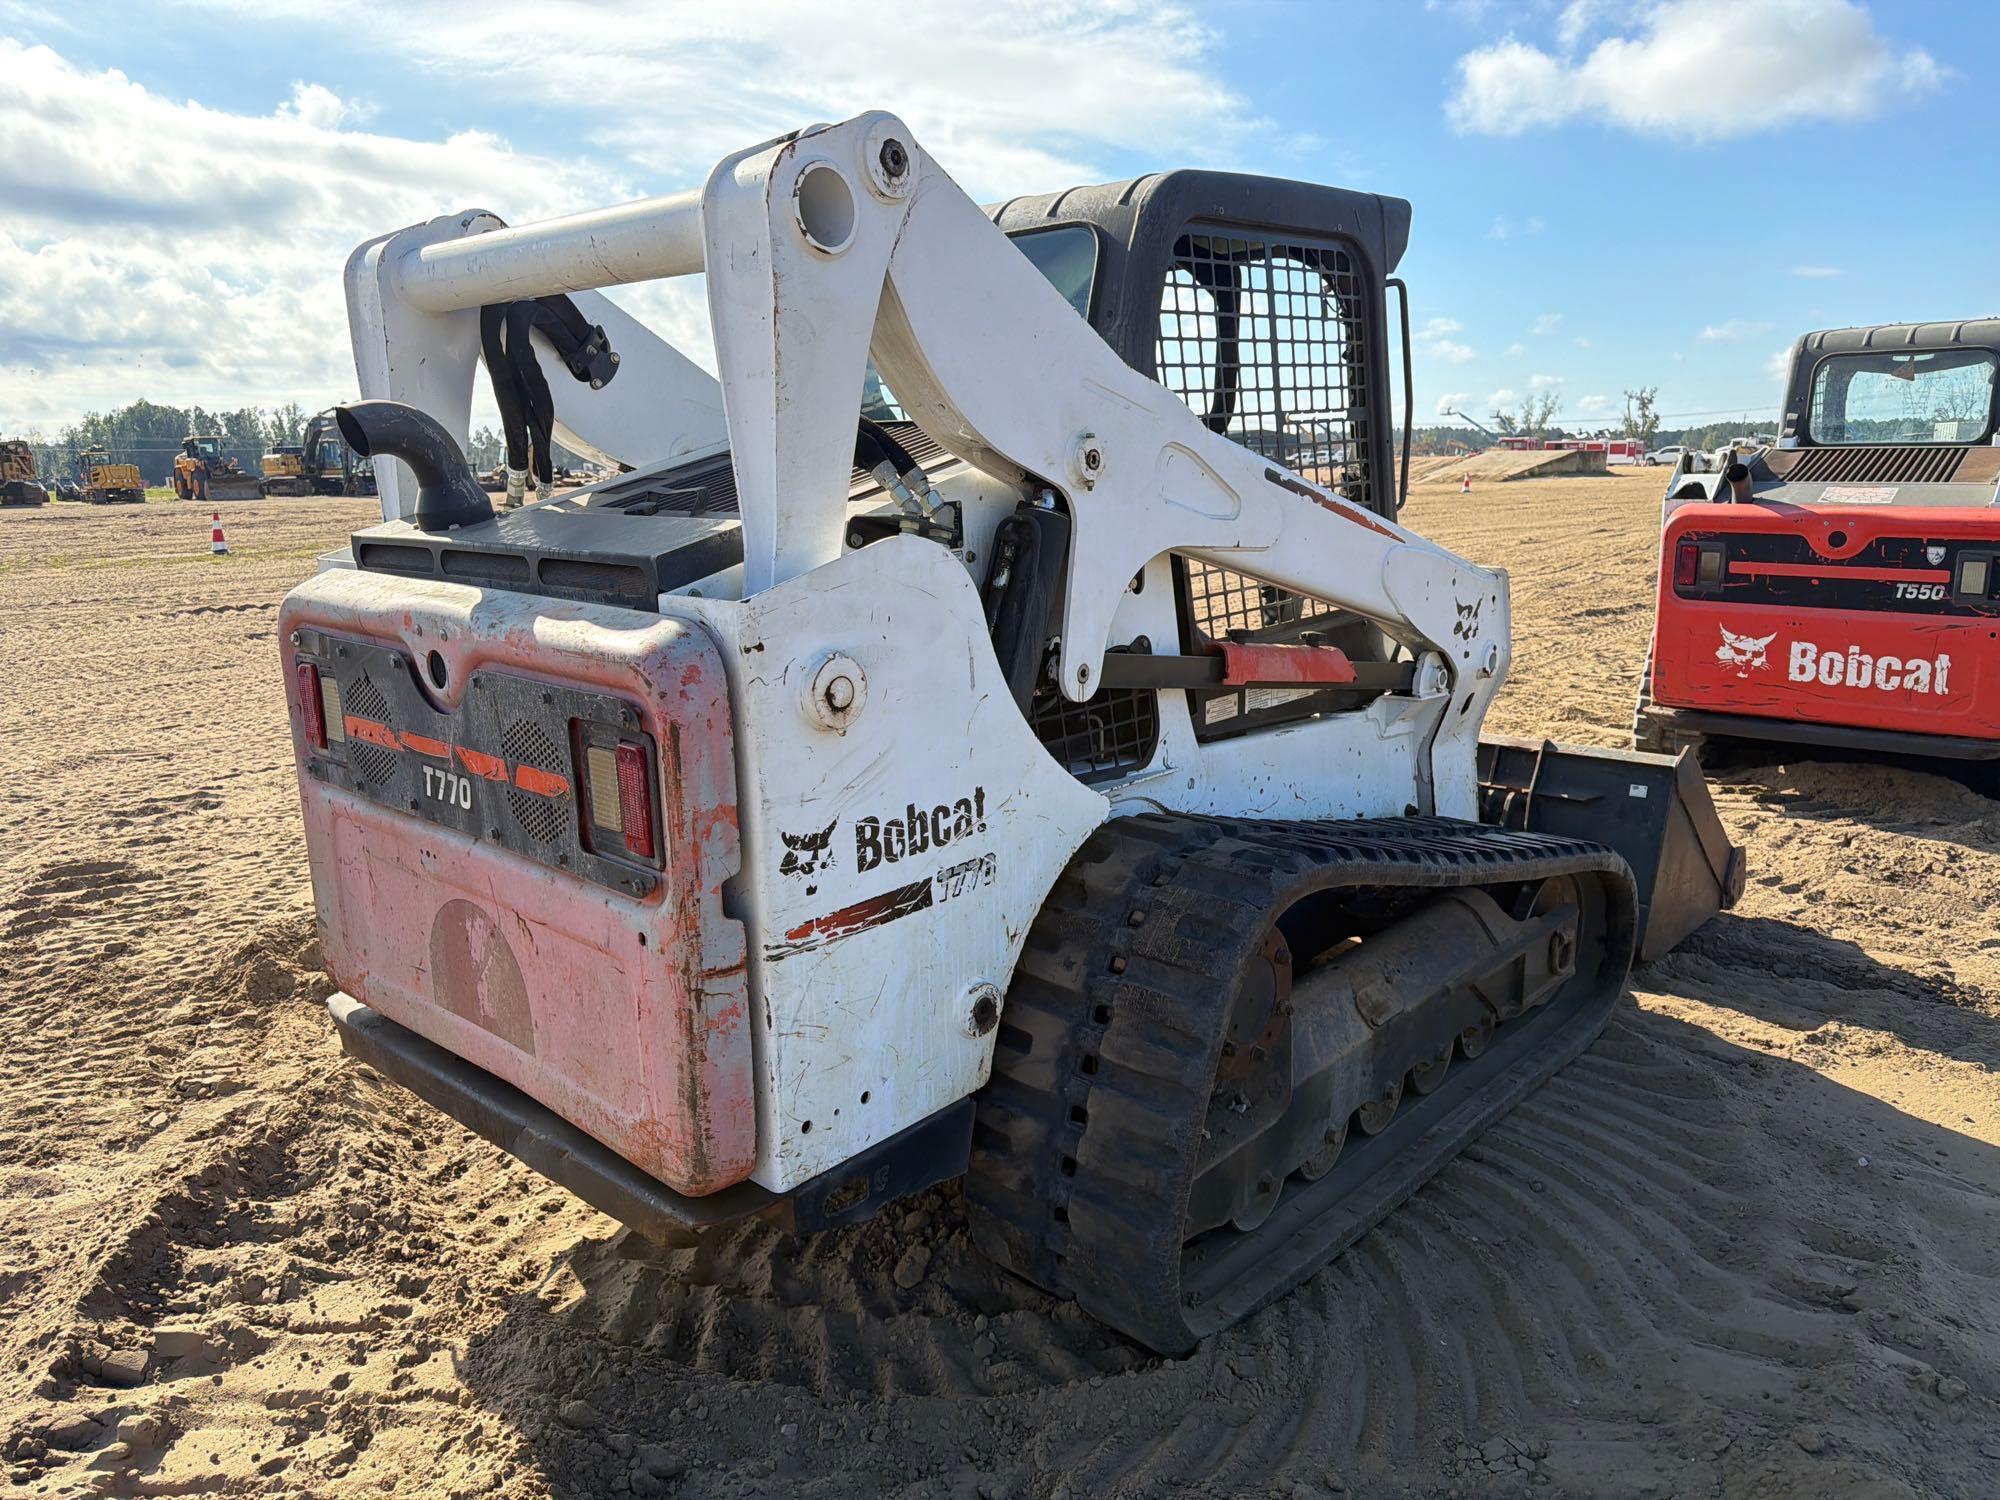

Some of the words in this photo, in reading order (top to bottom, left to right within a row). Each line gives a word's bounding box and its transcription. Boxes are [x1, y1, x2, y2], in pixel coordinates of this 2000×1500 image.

[1896, 583, 1946, 600] T550
[1788, 641, 1951, 695] Bobcat
[422, 764, 472, 810] T770
[856, 786, 987, 874] Bobcat
